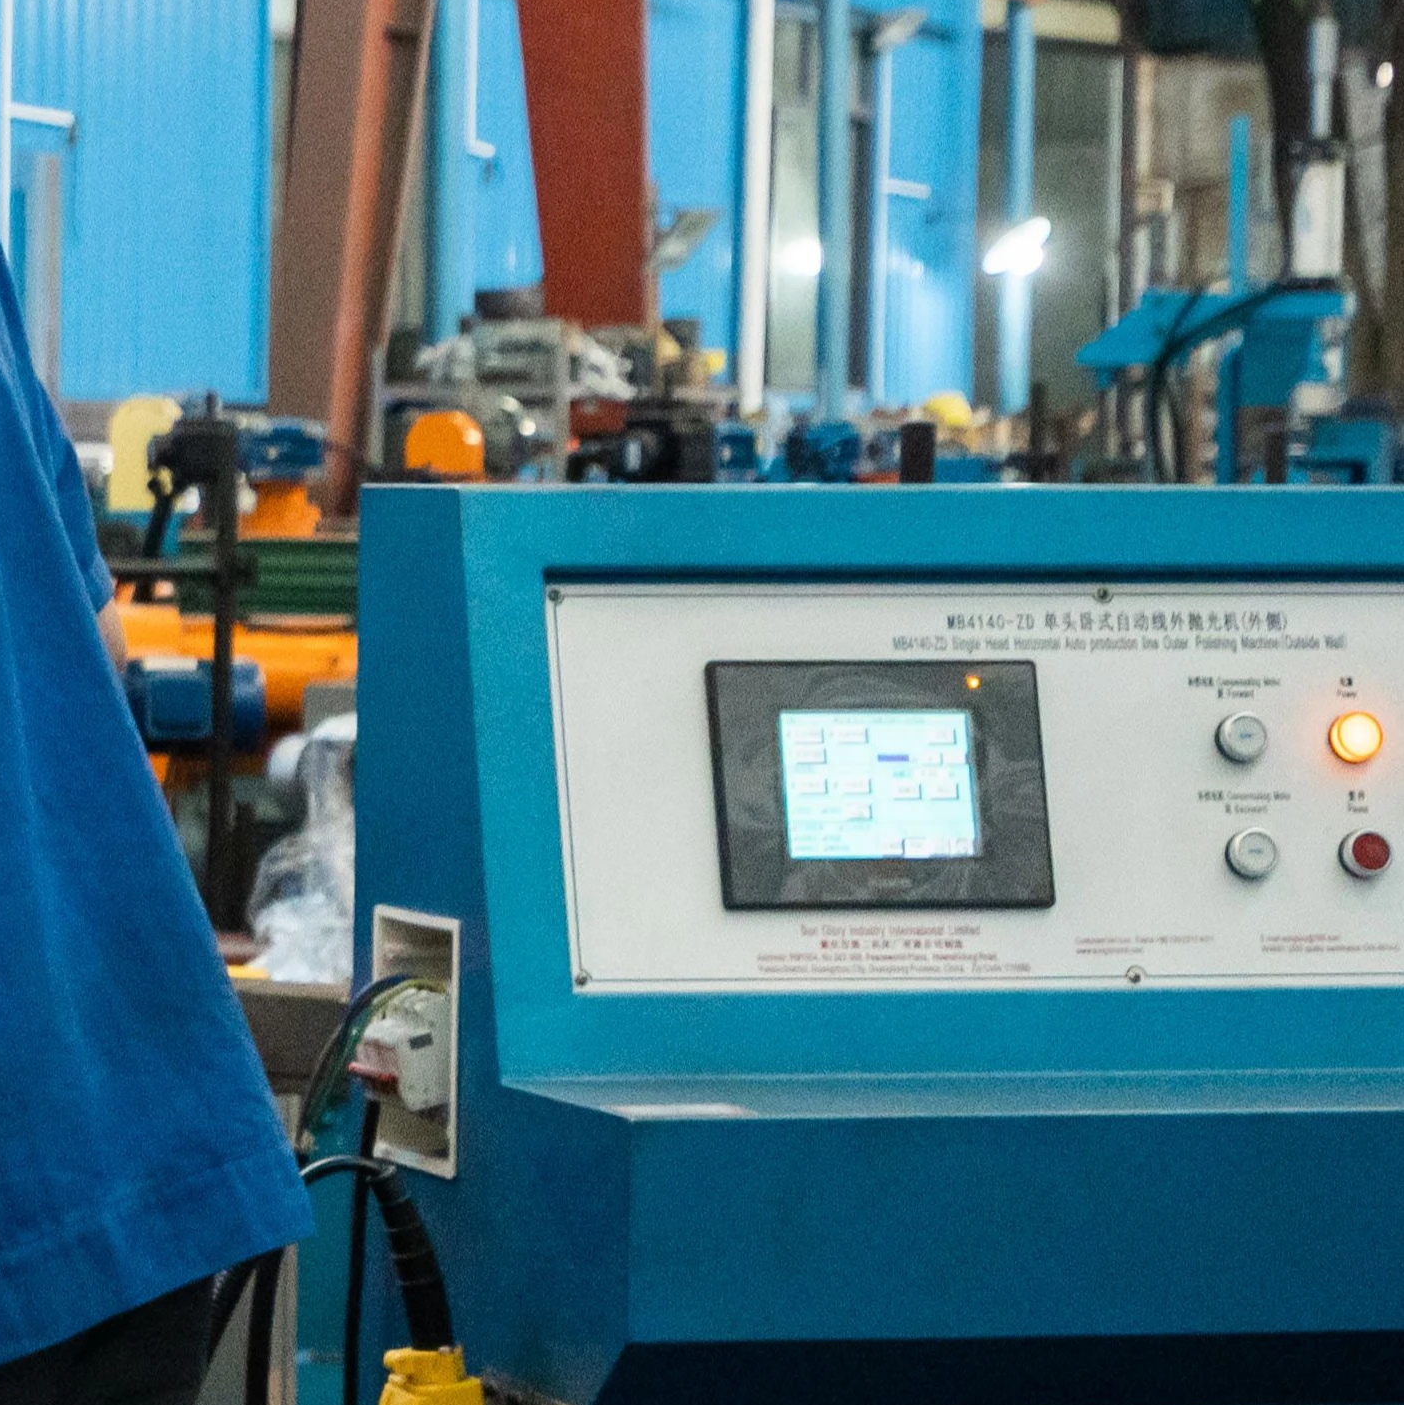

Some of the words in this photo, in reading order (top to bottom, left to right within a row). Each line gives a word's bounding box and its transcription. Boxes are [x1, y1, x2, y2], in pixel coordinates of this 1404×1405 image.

[947, 613, 1035, 631] MB4140-ZD
[952, 636, 980, 653] Single
[985, 636, 1009, 651] Head
[1014, 636, 1060, 651] Horizontal
[1065, 636, 1086, 651] Auto
[1090, 636, 1137, 653] production
[1195, 635, 1238, 653] Polishing
